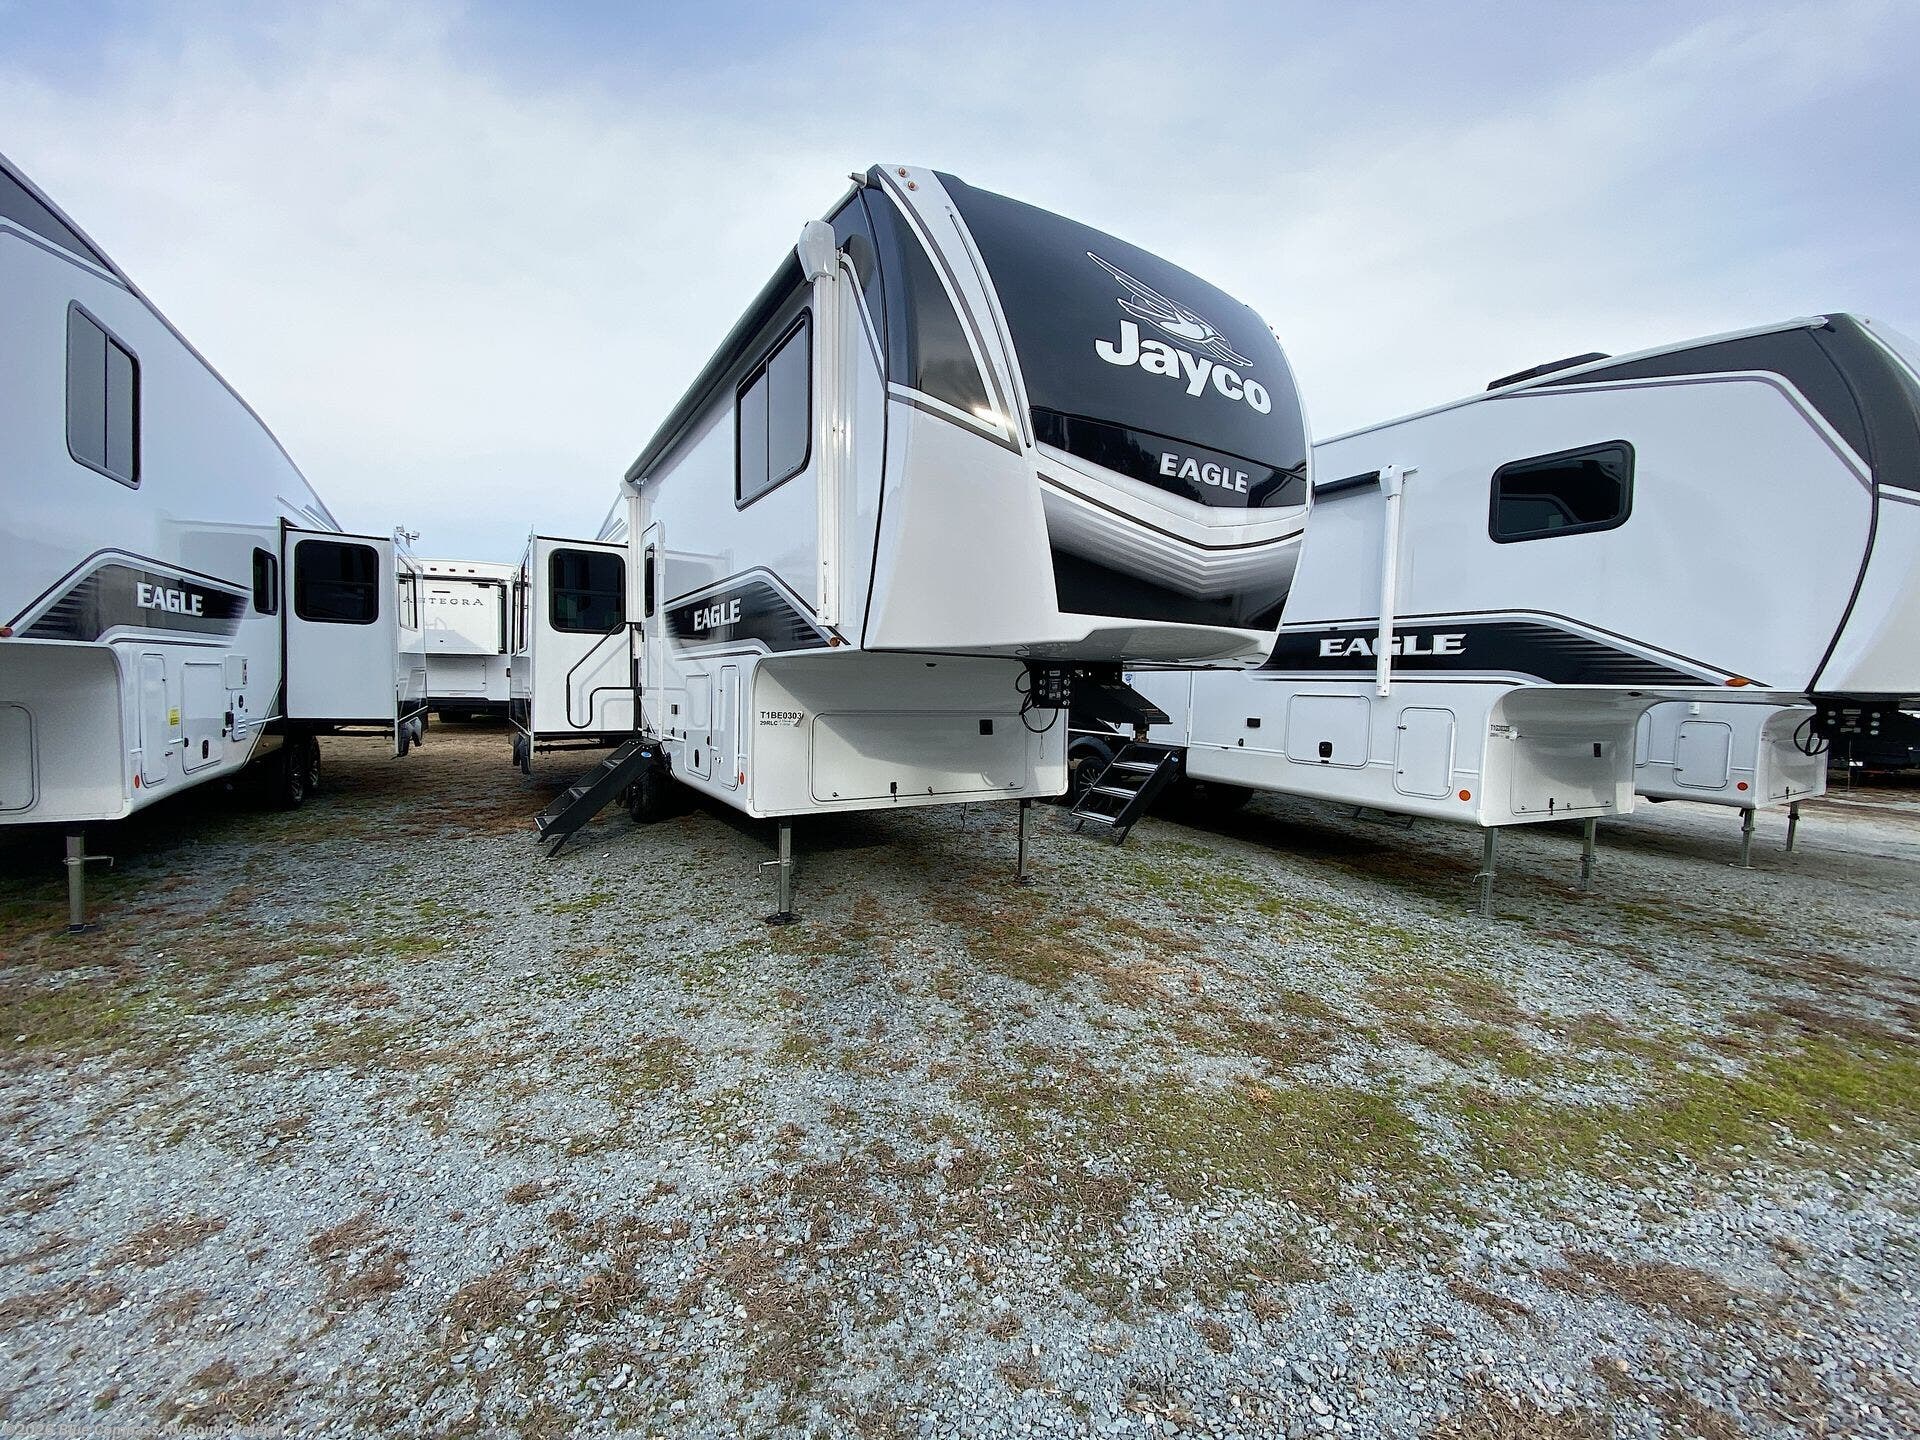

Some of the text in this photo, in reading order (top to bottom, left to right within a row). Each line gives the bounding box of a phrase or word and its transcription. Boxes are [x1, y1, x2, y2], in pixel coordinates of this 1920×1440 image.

[1095, 319, 1272, 415] Jayco
[1159, 452, 1249, 494] EAGLE
[137, 581, 204, 617] EAGLE
[694, 597, 742, 631] EAGLE
